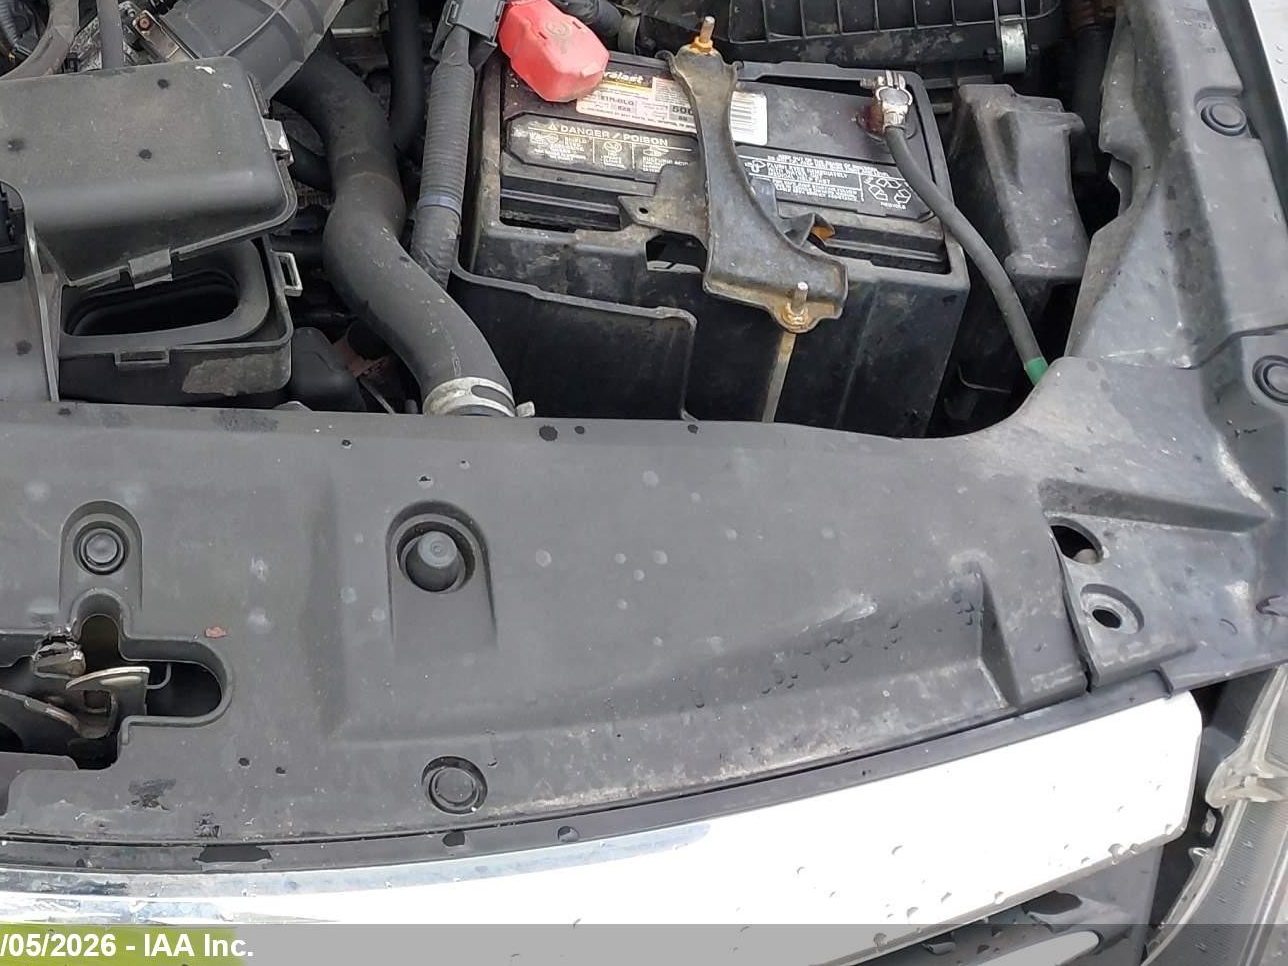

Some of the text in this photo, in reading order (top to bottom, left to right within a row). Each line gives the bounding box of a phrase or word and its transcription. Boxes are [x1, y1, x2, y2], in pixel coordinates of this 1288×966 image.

[604, 71, 644, 84] ralast
[560, 125, 610, 139] DANGER
[623, 133, 668, 147] POISON
